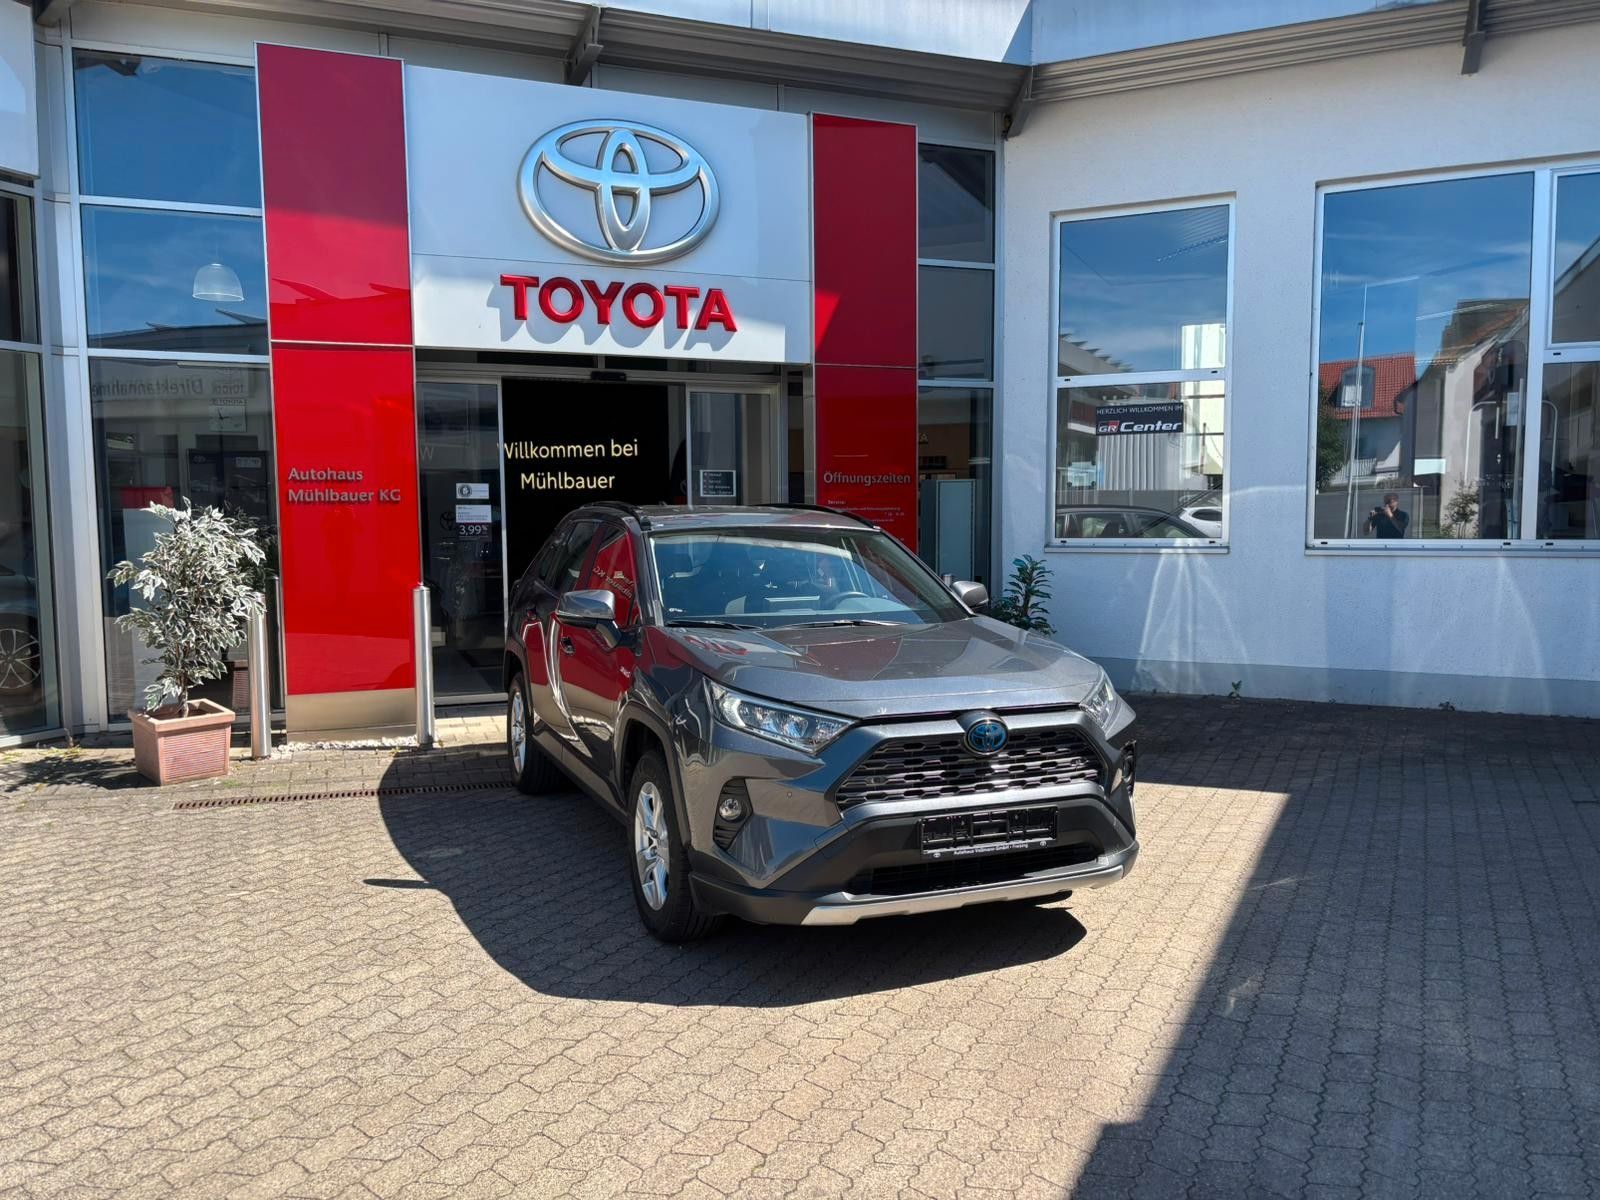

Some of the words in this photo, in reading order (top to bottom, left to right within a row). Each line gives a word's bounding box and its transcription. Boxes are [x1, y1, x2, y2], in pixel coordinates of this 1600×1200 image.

[500, 273, 738, 333] TOYOTA
[1096, 407, 1128, 415] HERZLICH
[1129, 403, 1174, 413] WILLKOMMEN
[1098, 420, 1120, 433] GR
[1120, 421, 1182, 432] Center
[611, 438, 638, 457] bei
[288, 467, 364, 481] Autohaus
[520, 471, 616, 490] Mühlbauer
[823, 470, 911, 487] Öffnungszeiten
[288, 488, 374, 503] Mühlbauer
[379, 489, 402, 502] KG
